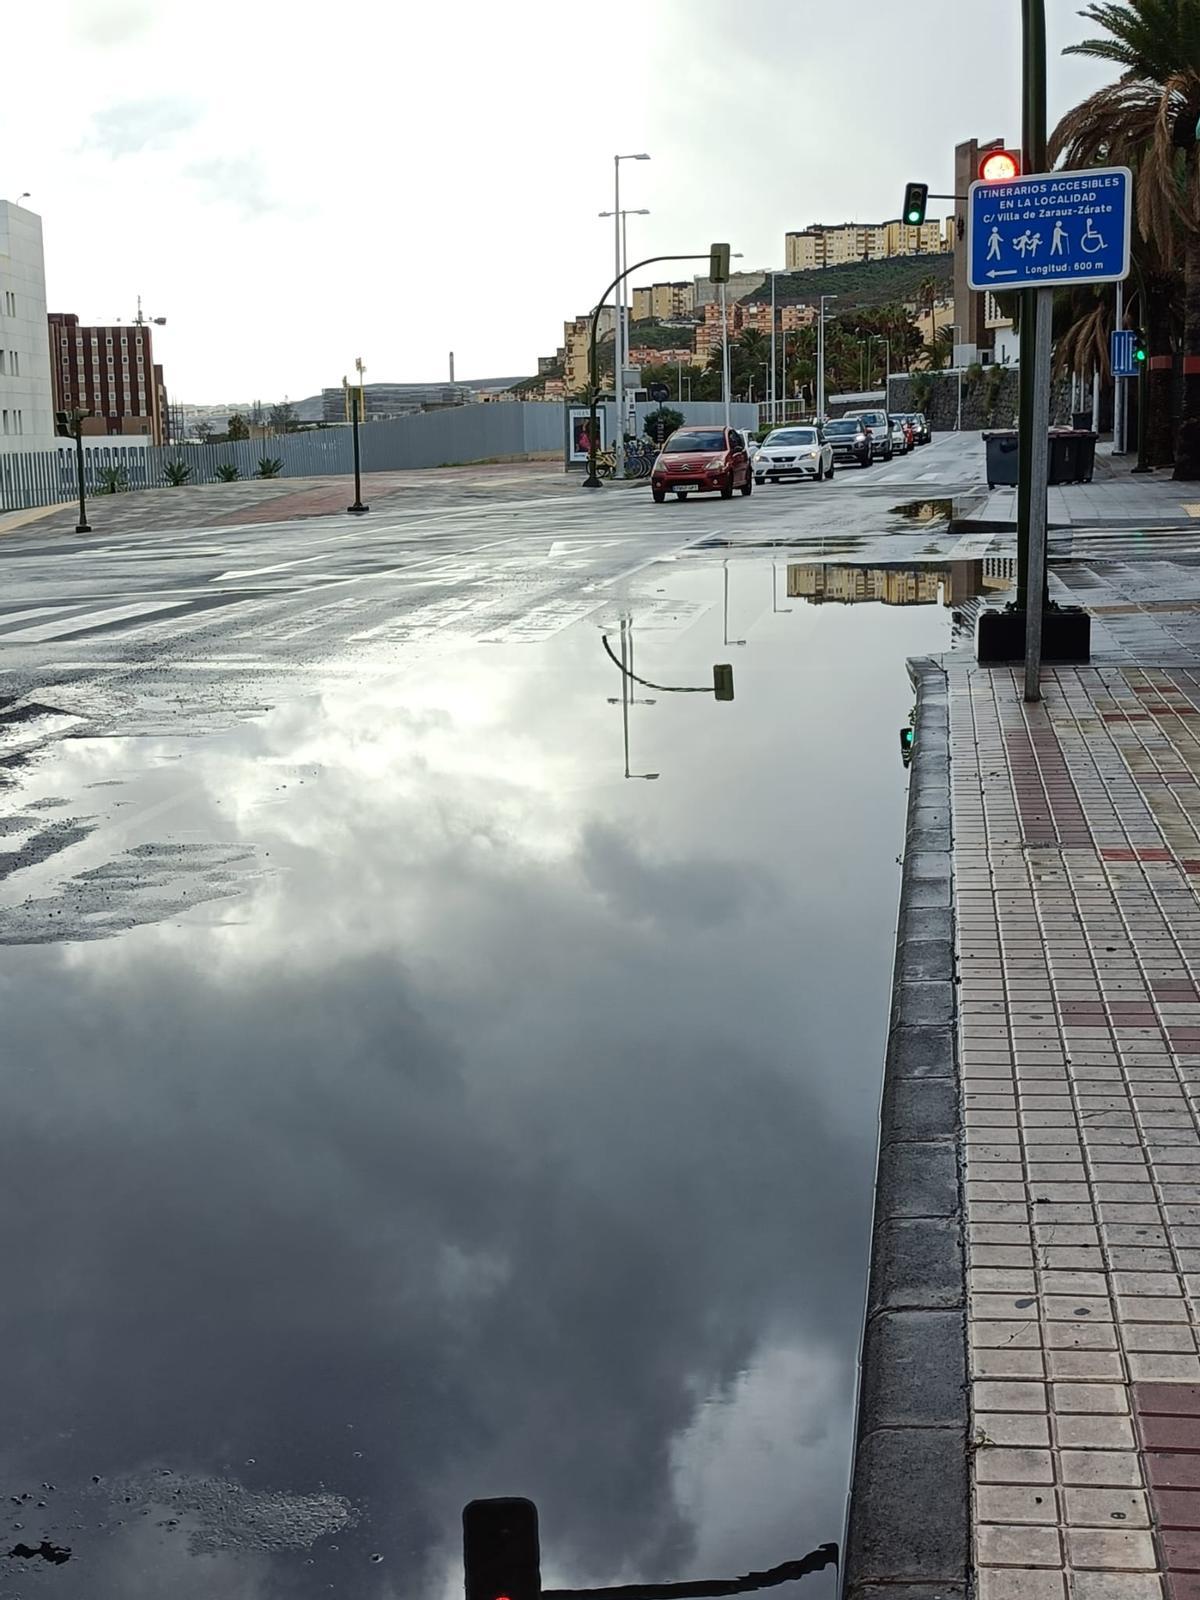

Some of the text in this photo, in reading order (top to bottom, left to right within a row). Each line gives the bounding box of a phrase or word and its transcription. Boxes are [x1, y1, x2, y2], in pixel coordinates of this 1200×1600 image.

[978, 177, 1120, 199] ITINERARIOS ACCESIBLES
[1000, 192, 1096, 209] EN LA LOCALIDAD
[983, 204, 1112, 223] C/ Villa de Zarauz-Zárate
[1025, 263, 1071, 275] Longitud:
[1074, 261, 1093, 270] 600
